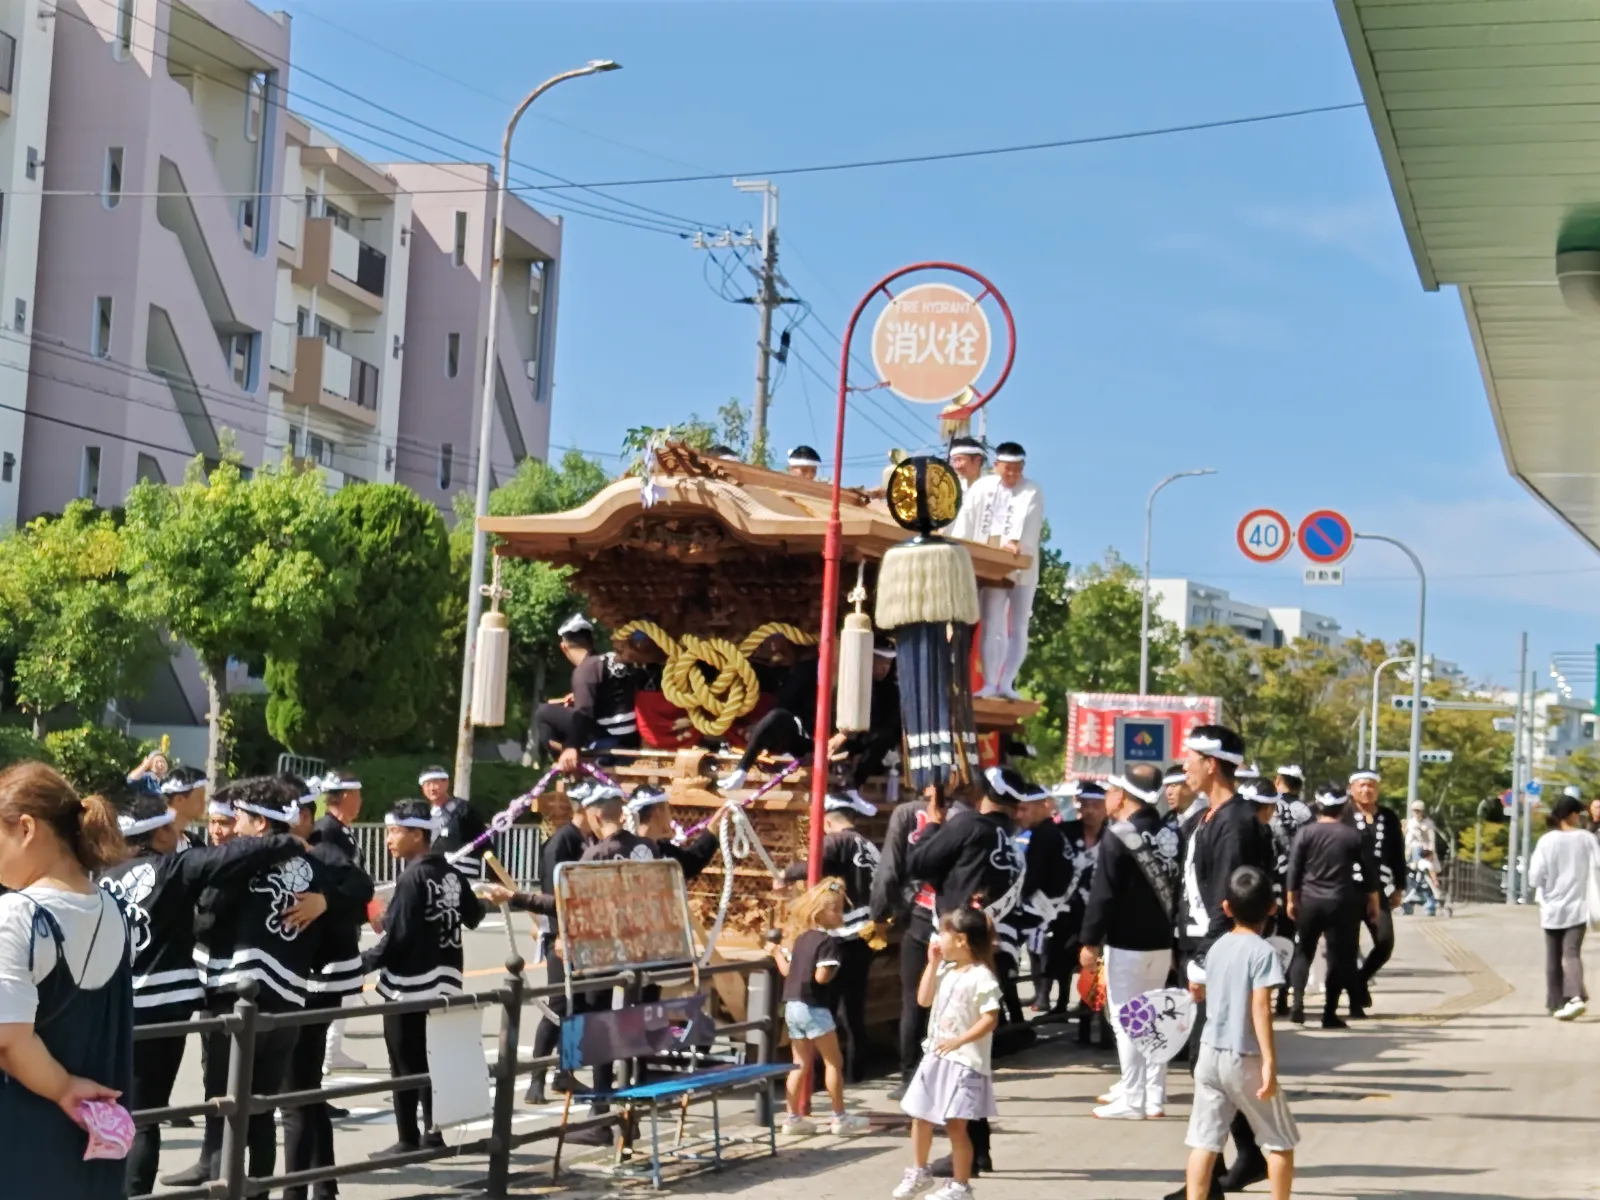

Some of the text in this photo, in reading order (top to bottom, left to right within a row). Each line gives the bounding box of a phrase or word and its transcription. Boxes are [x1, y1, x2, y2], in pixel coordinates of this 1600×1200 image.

[922, 300, 972, 314] HYDRANT
[884, 320, 981, 366] 消火栓
[1249, 523, 1280, 547] 40
[1305, 570, 1341, 581] 自動車
